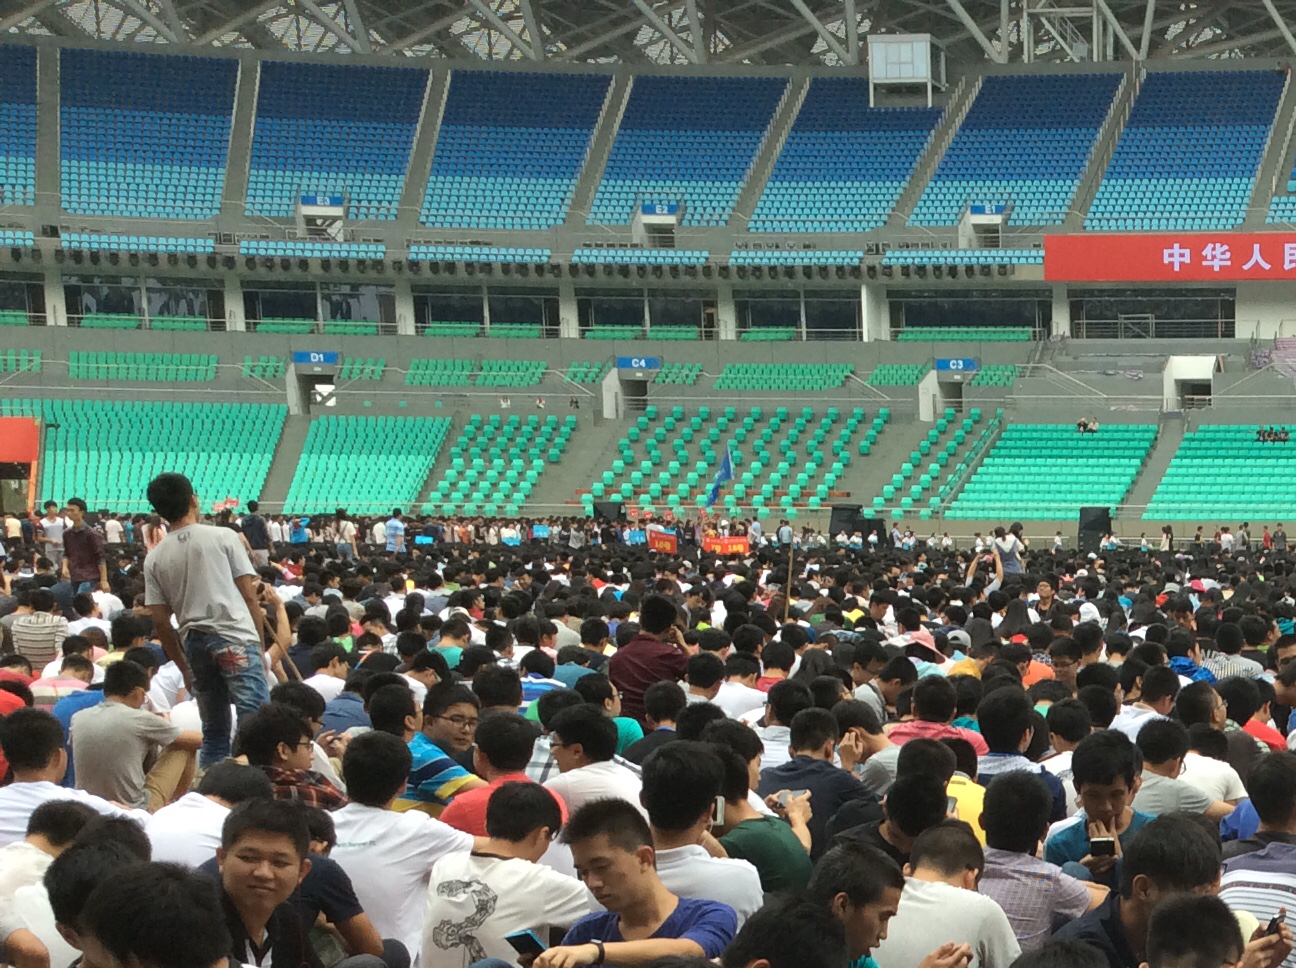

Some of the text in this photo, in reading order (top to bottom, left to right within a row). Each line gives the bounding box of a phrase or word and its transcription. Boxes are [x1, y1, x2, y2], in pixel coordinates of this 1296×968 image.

[316, 197, 331, 205] E3
[655, 205, 668, 213] E2
[985, 205, 996, 213] E1
[310, 353, 324, 362] D1
[631, 358, 646, 367] C4
[949, 360, 964, 369] C3
